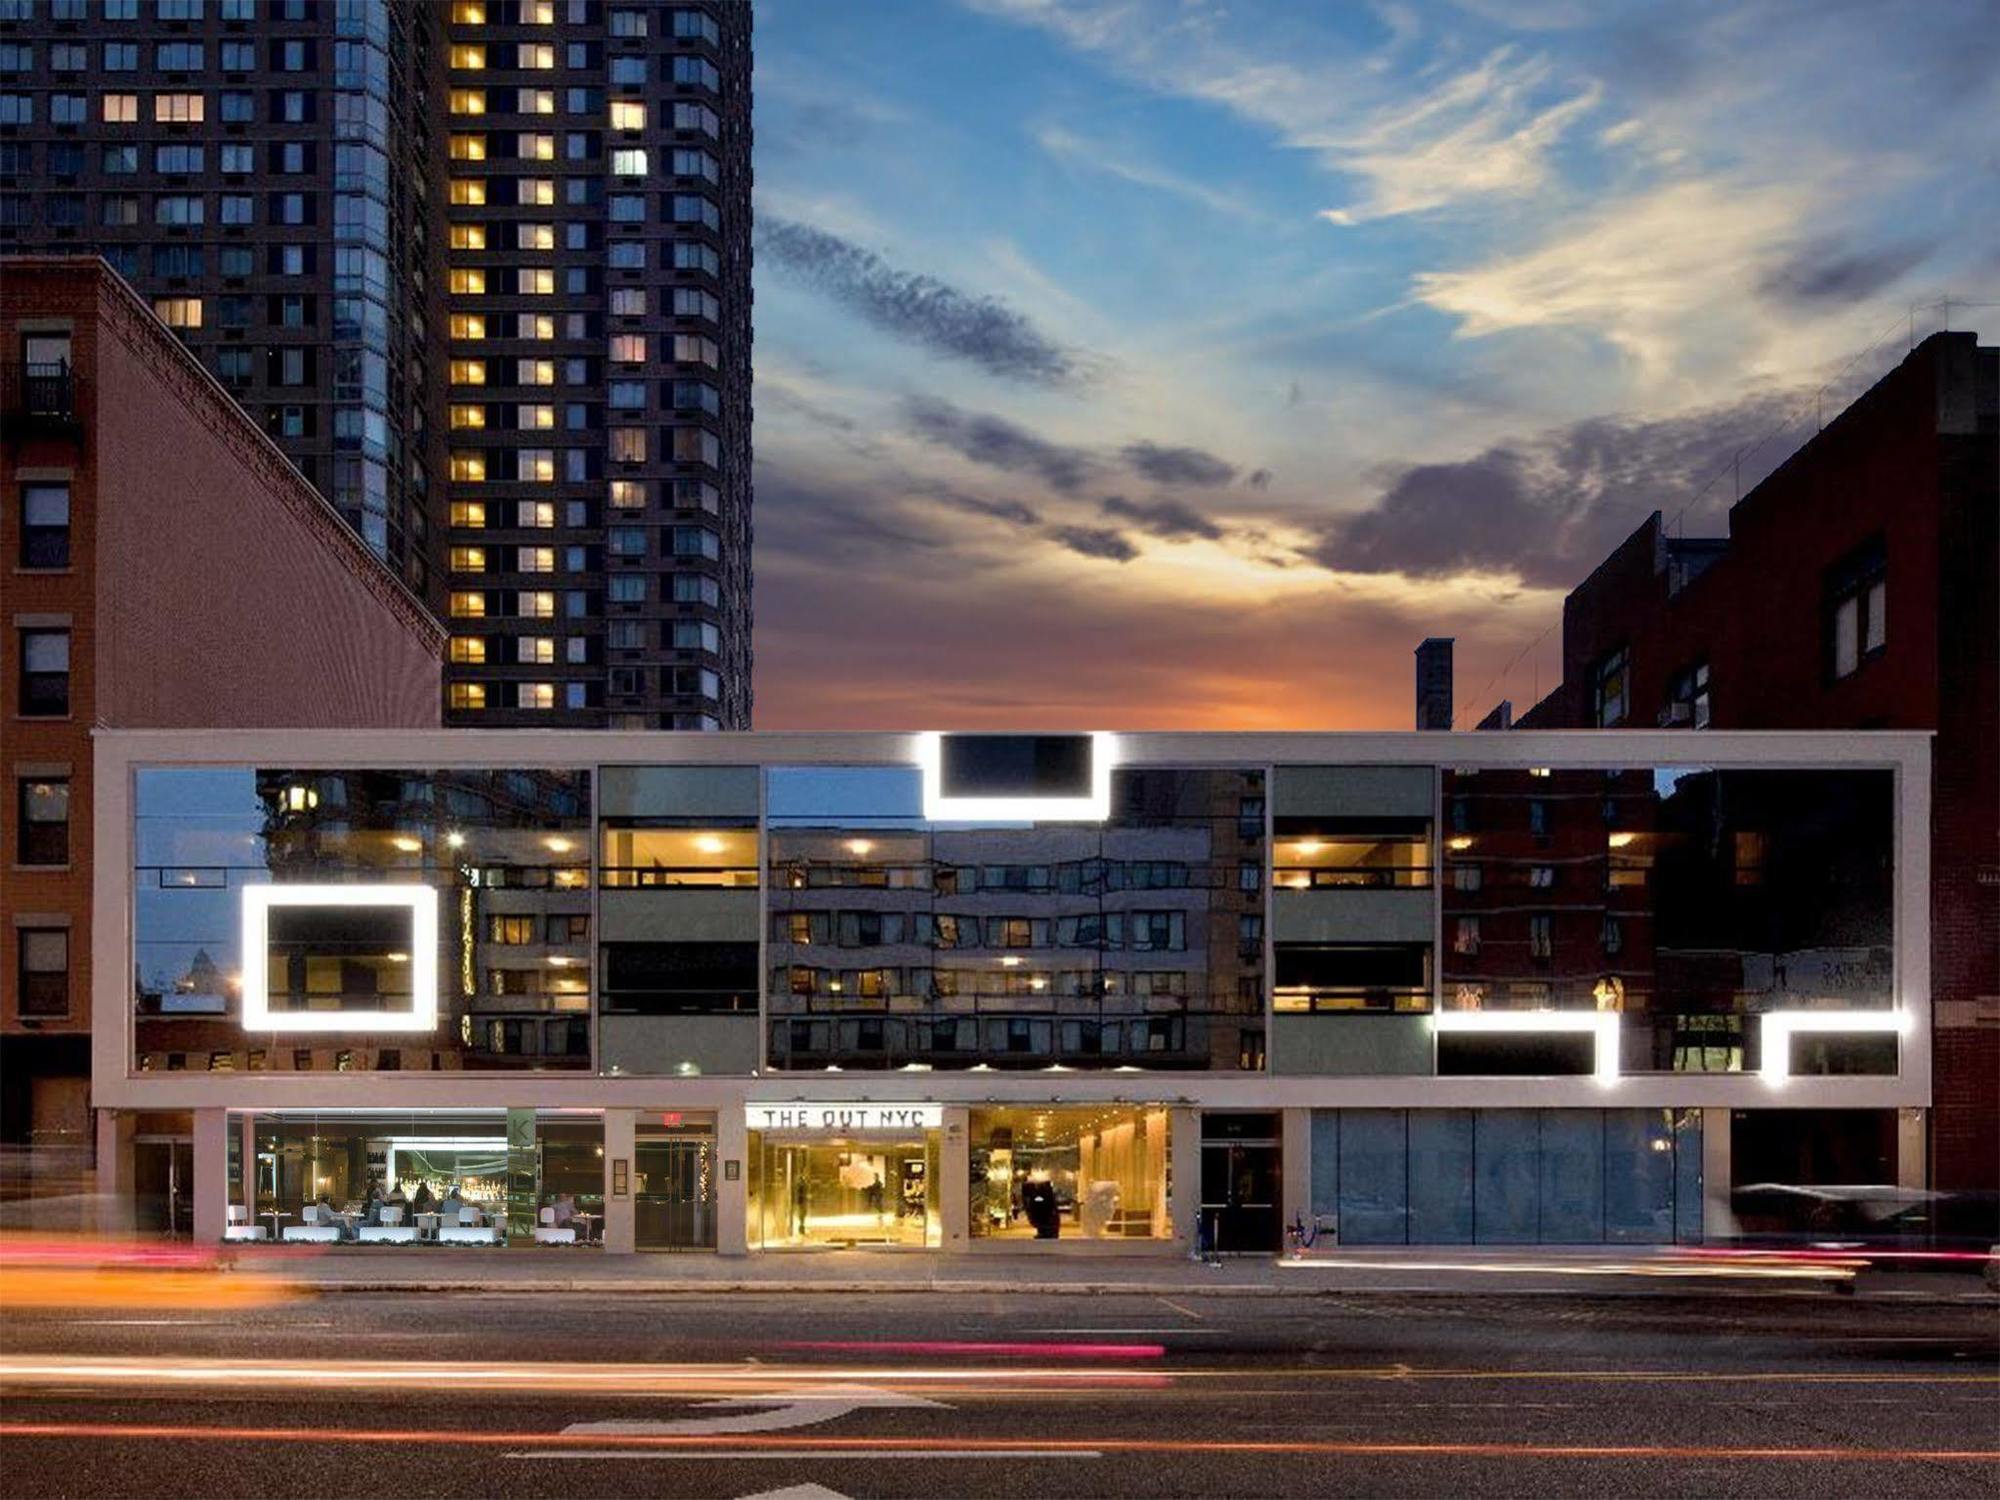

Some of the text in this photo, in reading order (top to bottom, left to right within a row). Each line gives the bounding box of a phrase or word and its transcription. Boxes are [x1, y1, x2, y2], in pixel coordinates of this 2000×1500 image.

[763, 1110, 924, 1128] THE OUT NYC
